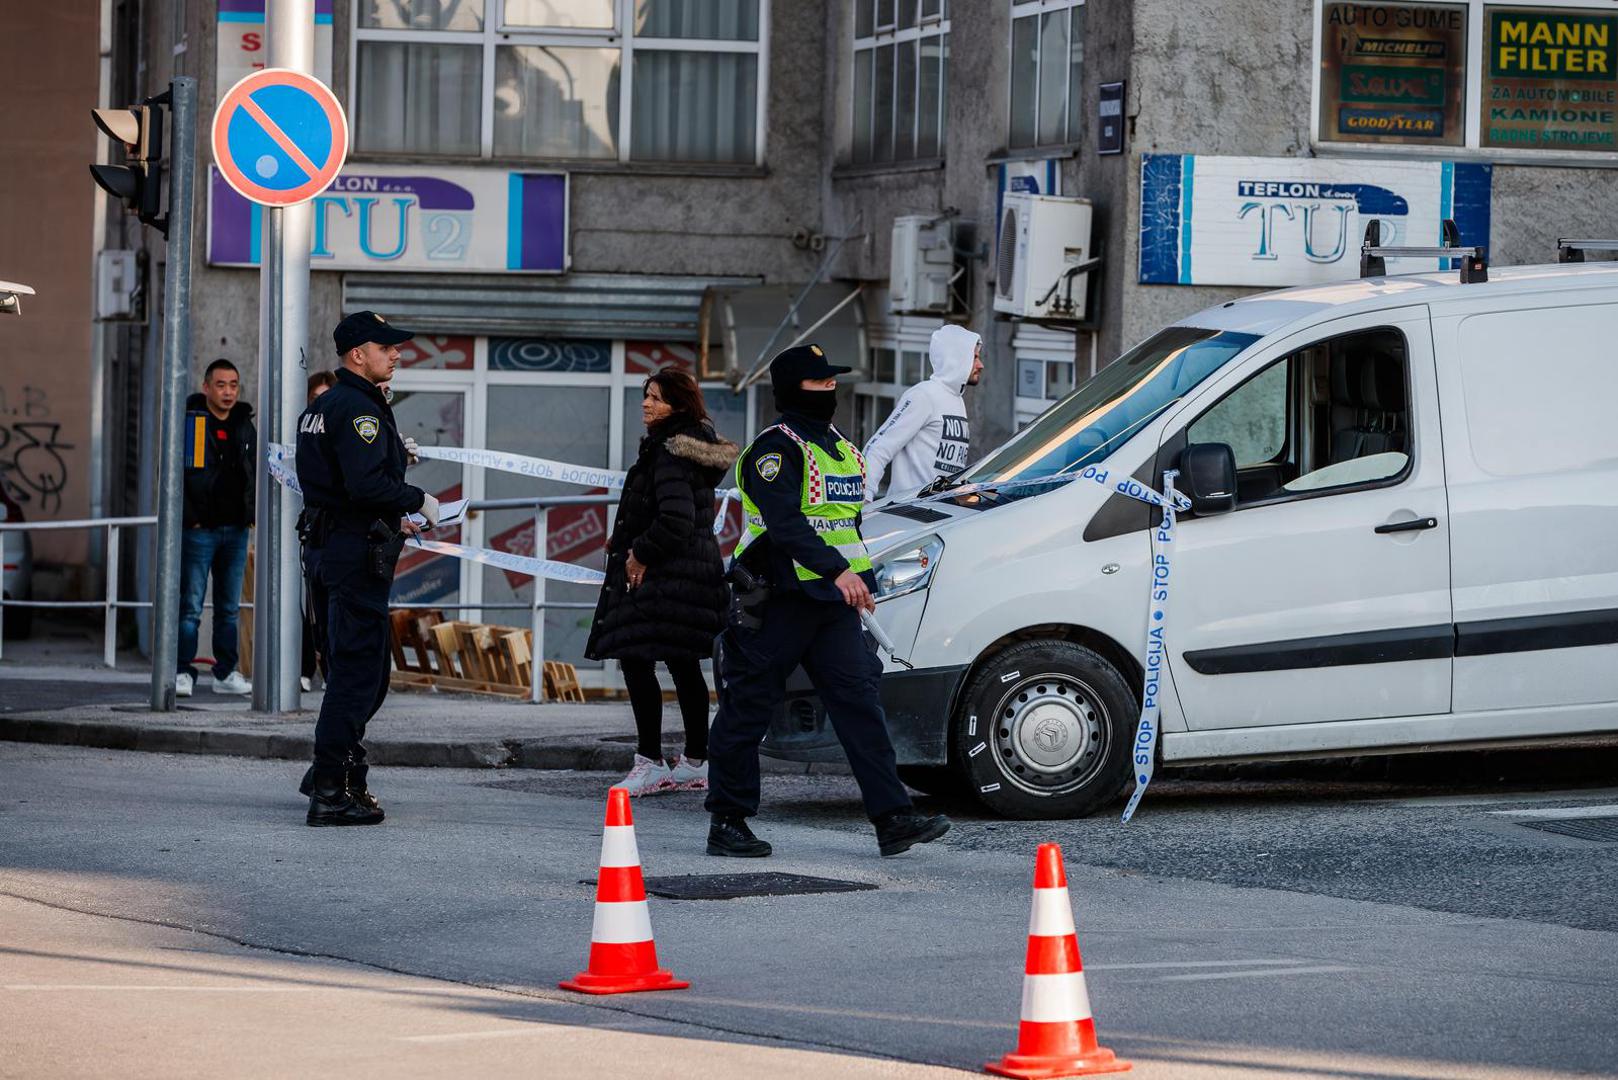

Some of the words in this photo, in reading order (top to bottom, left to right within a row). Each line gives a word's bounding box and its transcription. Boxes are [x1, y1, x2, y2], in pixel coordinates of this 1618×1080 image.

[1329, 7, 1388, 27] AUTO
[1396, 11, 1461, 30] GUME
[1500, 20, 1608, 47] MANN
[1500, 47, 1607, 73] FILTER
[1491, 87, 1510, 100] ZA
[1516, 89, 1615, 103] AUTOMOBILE
[1346, 114, 1435, 131] GOODYEAR
[1490, 108, 1614, 124] KAMIONE
[1541, 130, 1614, 145] STROJEVE
[1240, 182, 1320, 198] TEFLON
[945, 418, 961, 438] NO
[935, 441, 956, 461] NO
[1153, 554, 1170, 601] STOP
[1136, 720, 1154, 765] STOP
[1145, 626, 1163, 708] POLICIJA
